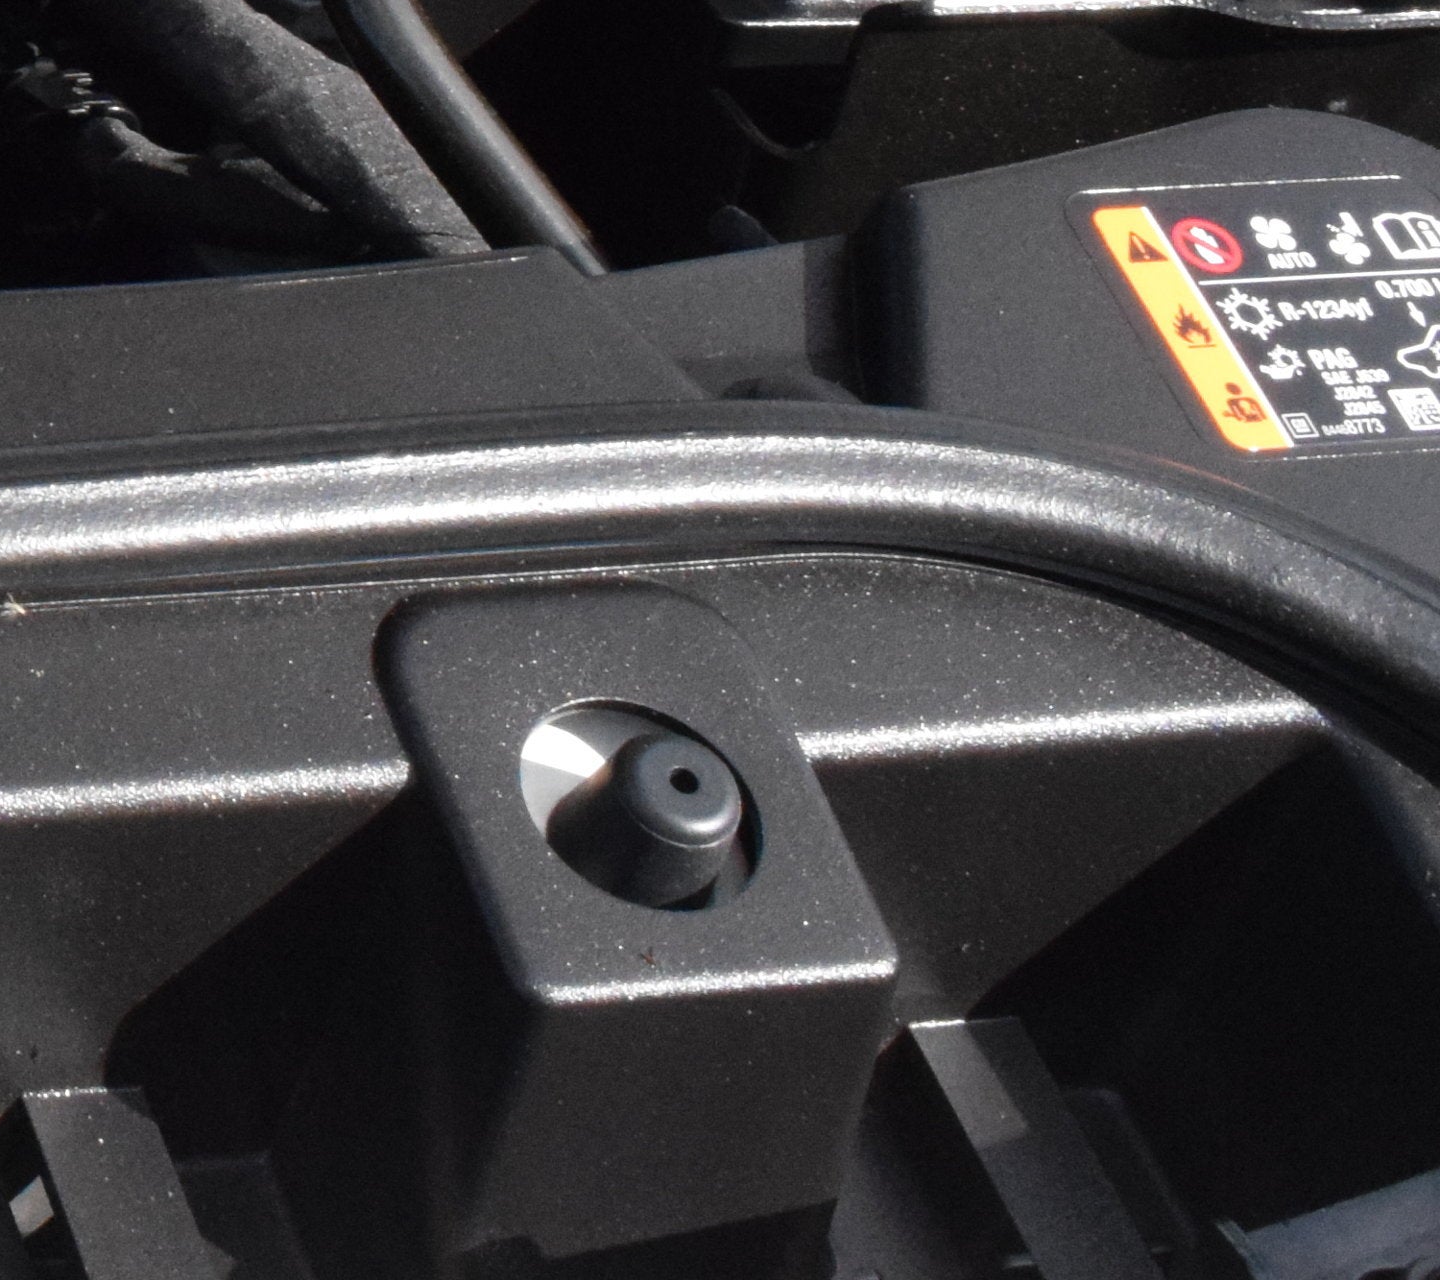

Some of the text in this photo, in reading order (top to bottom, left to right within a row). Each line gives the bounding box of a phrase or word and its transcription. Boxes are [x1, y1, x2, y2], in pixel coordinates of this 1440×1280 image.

[1267, 251, 1317, 269] AUTO
[1374, 278, 1434, 299] 0.700
[1277, 297, 1374, 321] R-1234yf
[1307, 347, 1359, 370] PAG
[1321, 370, 1354, 386] SAE
